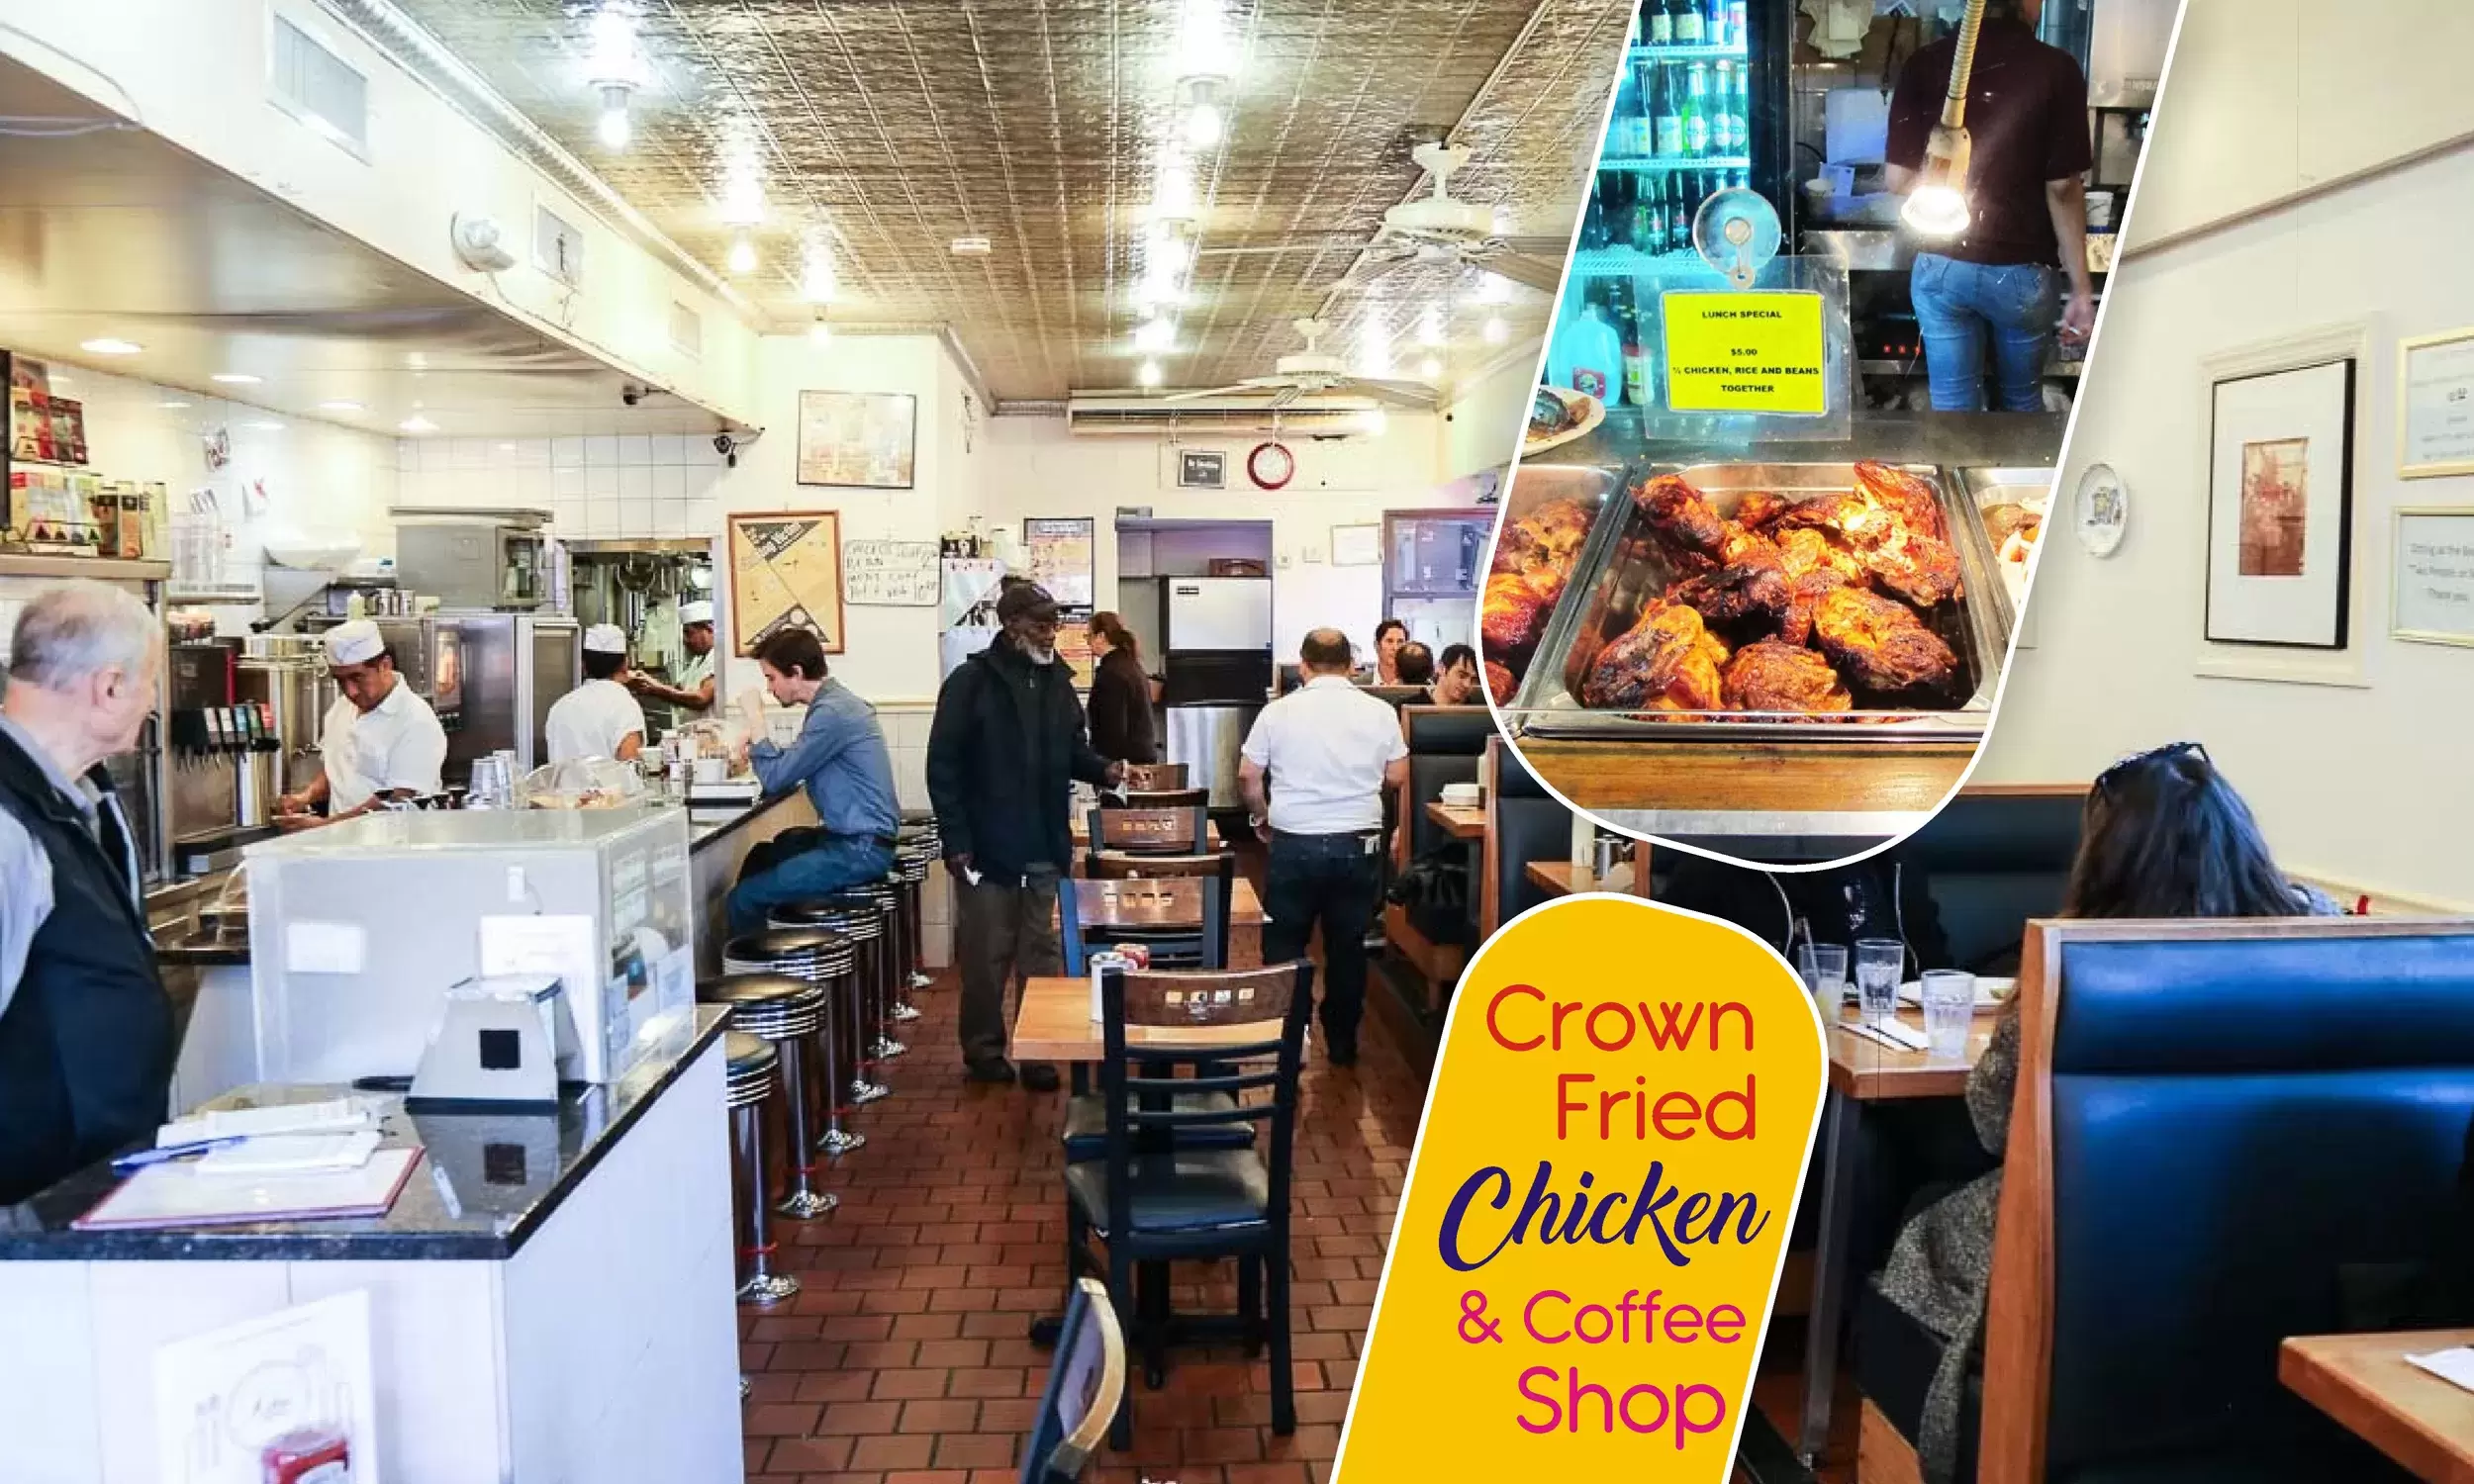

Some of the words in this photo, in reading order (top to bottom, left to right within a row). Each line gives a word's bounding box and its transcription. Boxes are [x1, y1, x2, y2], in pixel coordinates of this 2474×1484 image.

[1730, 347, 1758, 357] $5.00
[1683, 366, 1732, 376] CHICKEN,
[1734, 366, 1758, 375] RICE
[1720, 384, 1775, 393] TOGETHER
